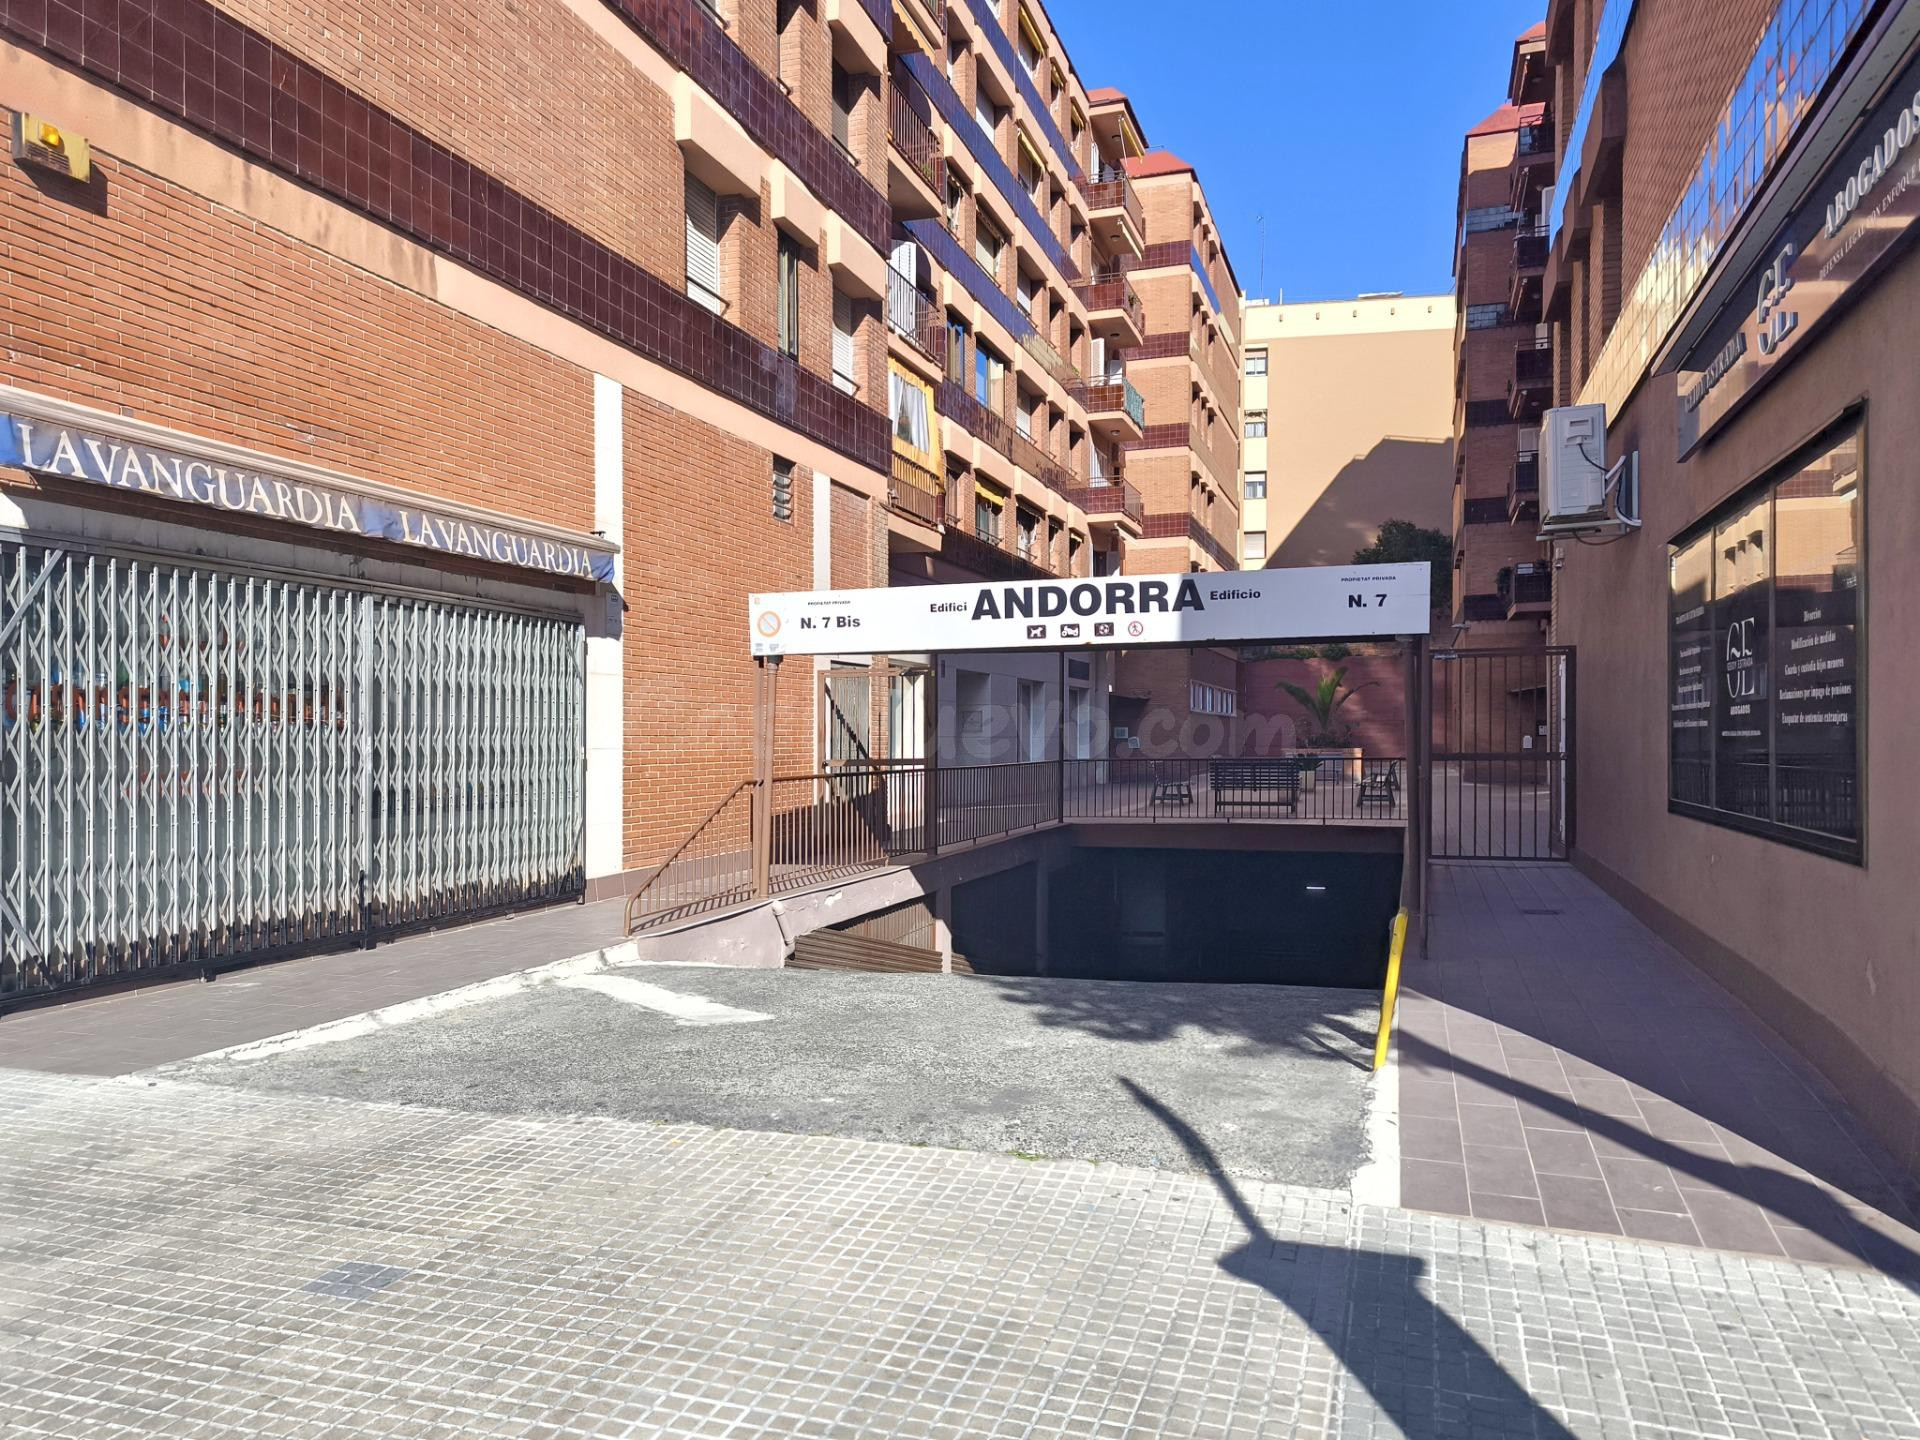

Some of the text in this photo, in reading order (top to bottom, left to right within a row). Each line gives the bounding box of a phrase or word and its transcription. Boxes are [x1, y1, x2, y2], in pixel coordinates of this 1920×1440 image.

[1824, 90, 1920, 239] ABOGADOS
[971, 578, 1205, 621] ANDORRA
[1210, 588, 1261, 601] Edificio
[1348, 593, 1388, 609] N. 7
[930, 602, 968, 614] Edifici
[800, 615, 861, 630] N. 7 Bis
